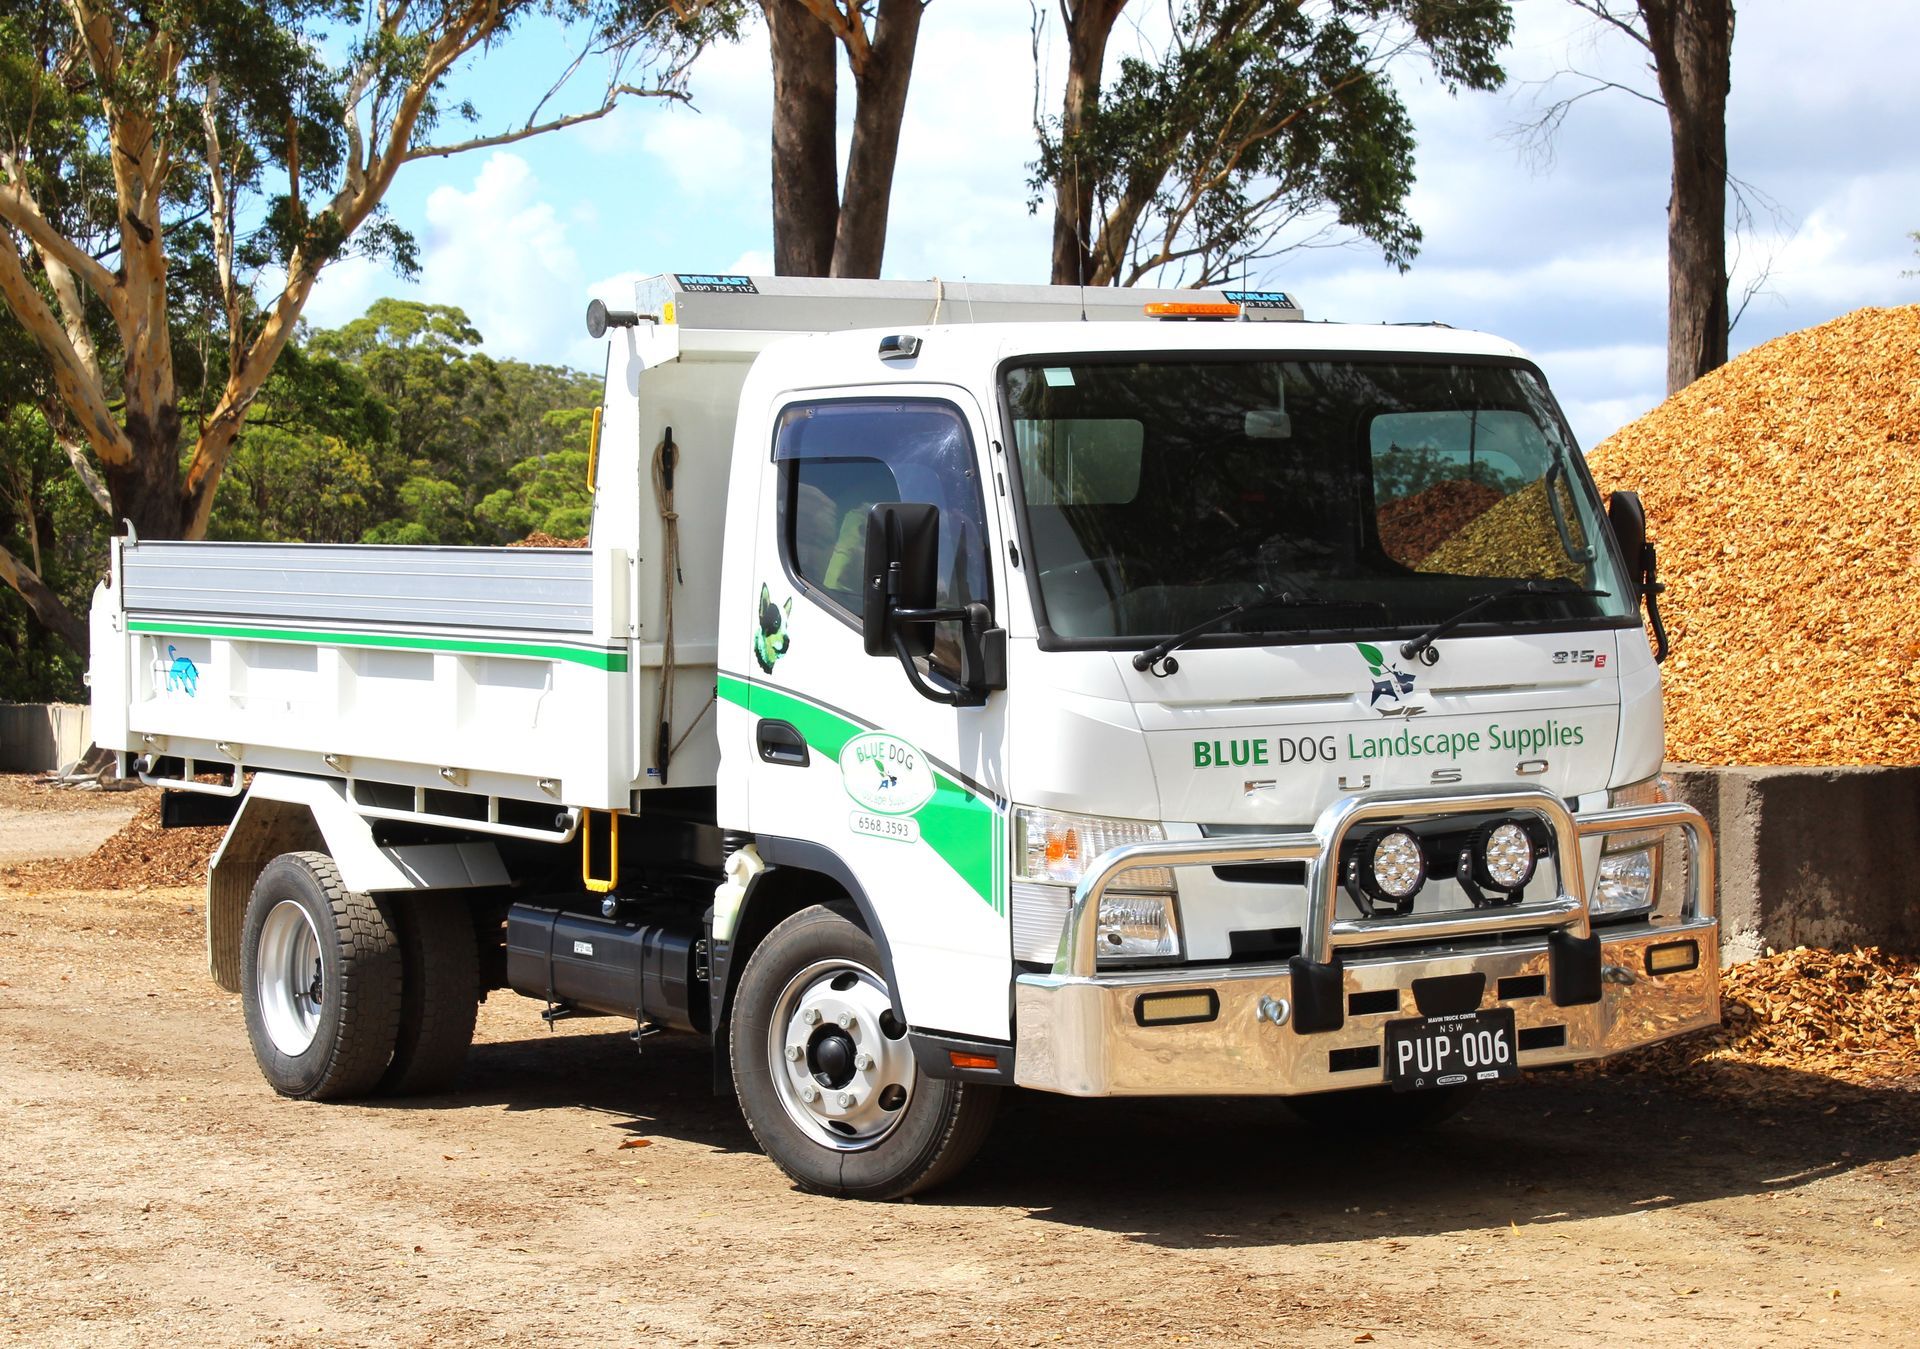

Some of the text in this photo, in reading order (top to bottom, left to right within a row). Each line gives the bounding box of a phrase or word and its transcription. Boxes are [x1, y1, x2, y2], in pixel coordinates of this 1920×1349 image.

[684, 284, 711, 292] 1300
[736, 285, 755, 293] 112
[856, 742, 914, 770] BLUE DOG
[1193, 719, 1584, 768] BLUE DOG Landscape Supplies
[1244, 759, 1549, 797] FUSO
[858, 816, 909, 837] 6568.3593
